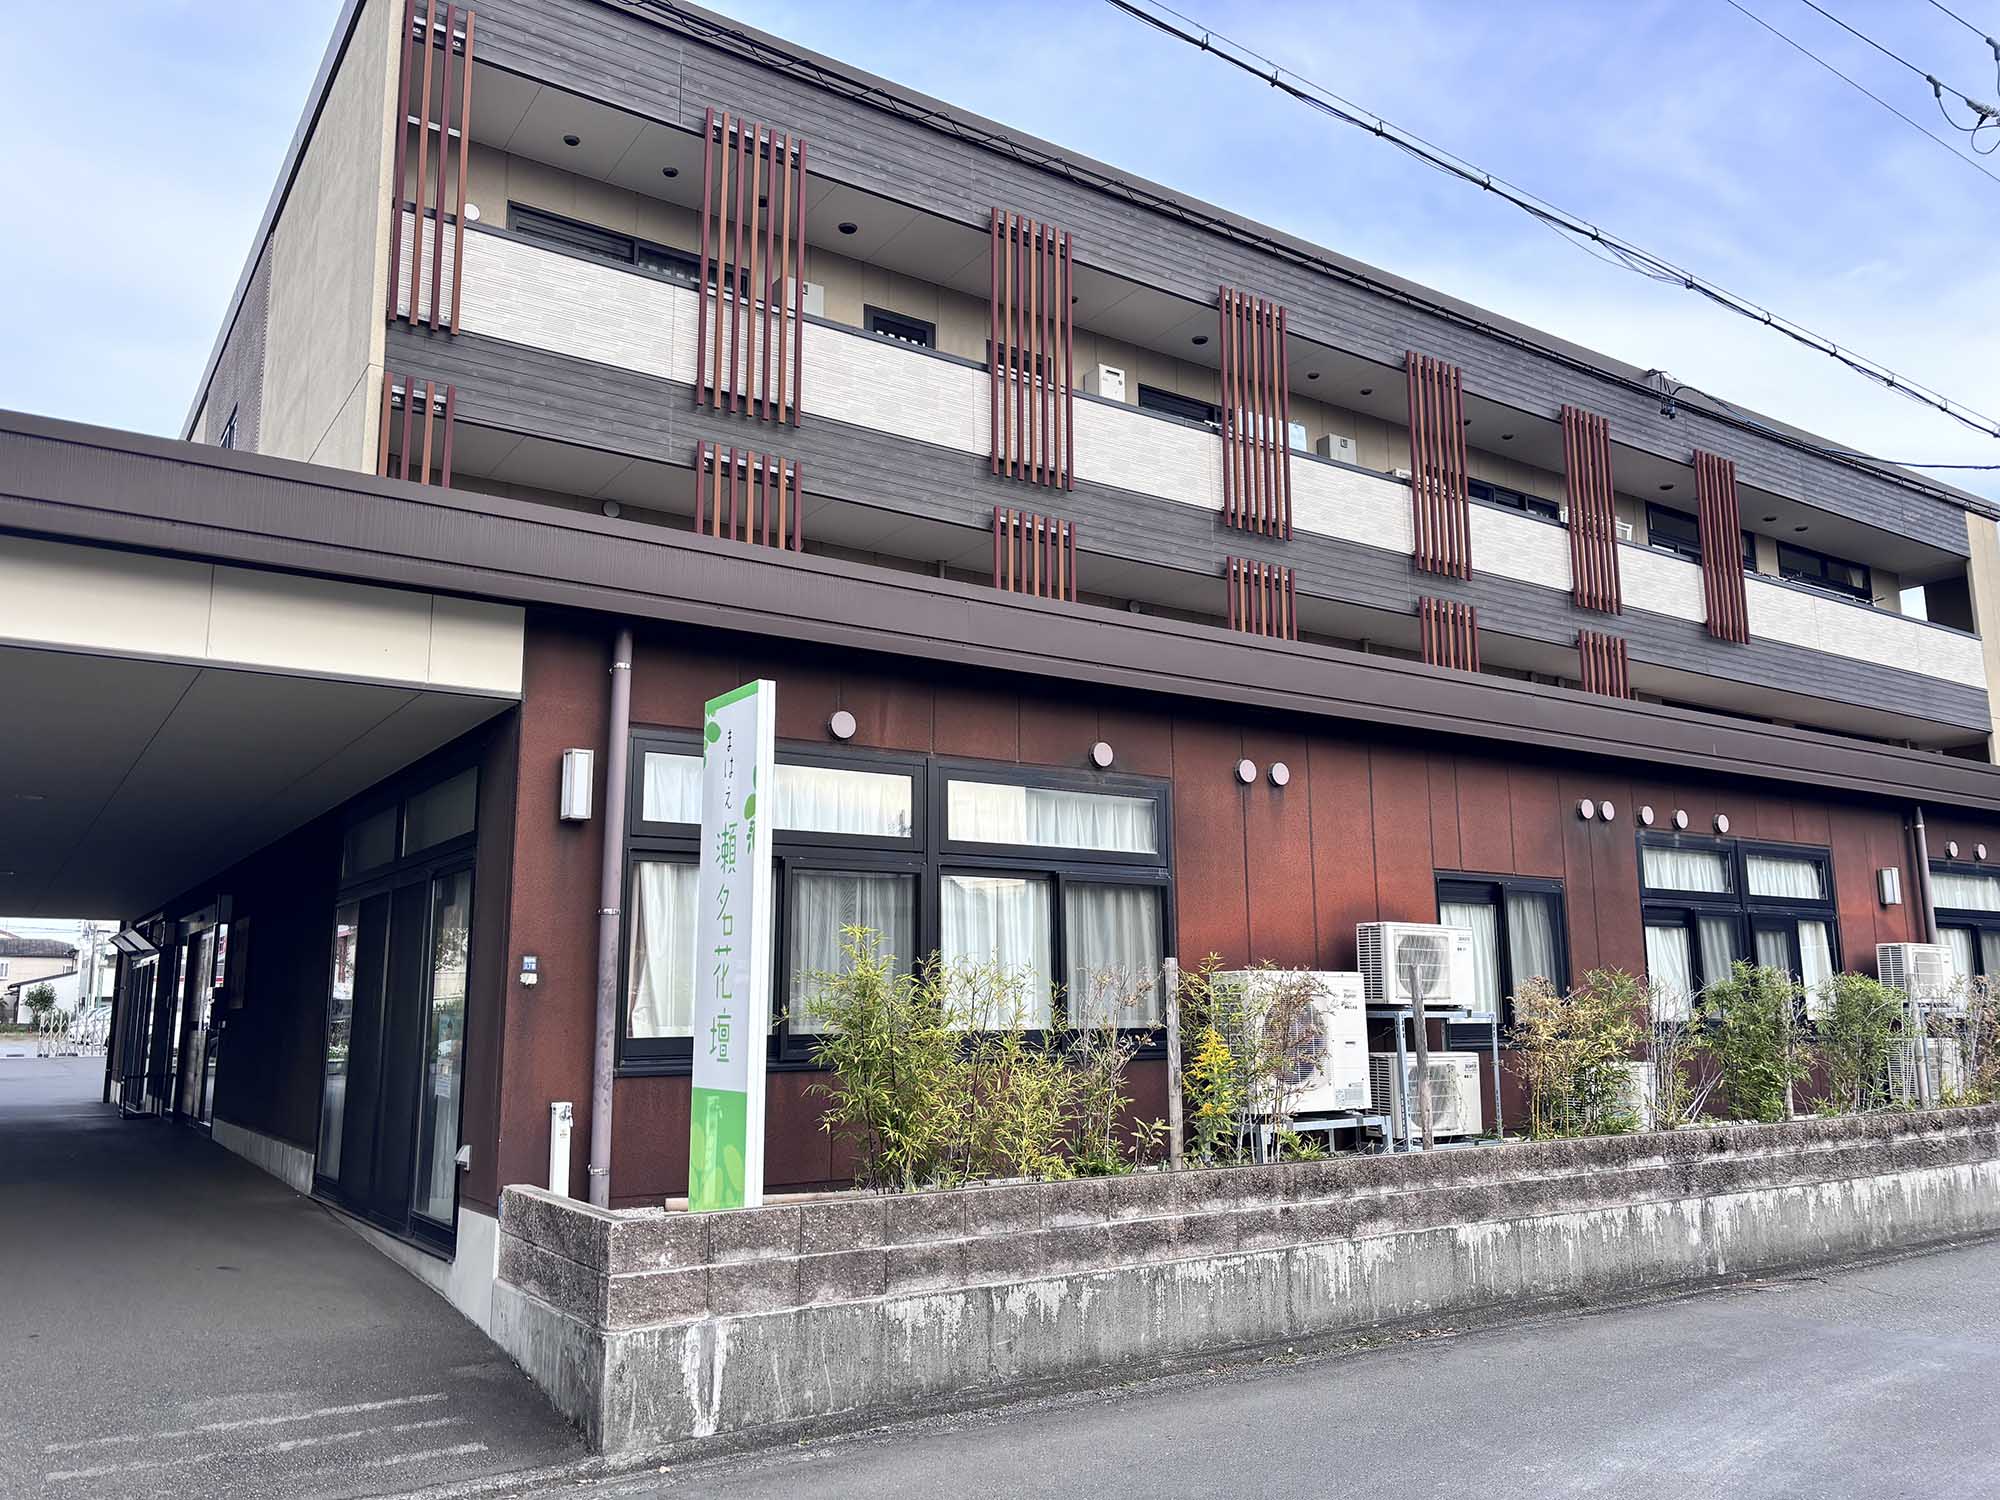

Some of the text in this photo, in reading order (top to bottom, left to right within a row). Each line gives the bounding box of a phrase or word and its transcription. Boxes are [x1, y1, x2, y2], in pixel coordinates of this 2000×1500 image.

[709, 728, 738, 1062] まはえ 瀬名花壇
